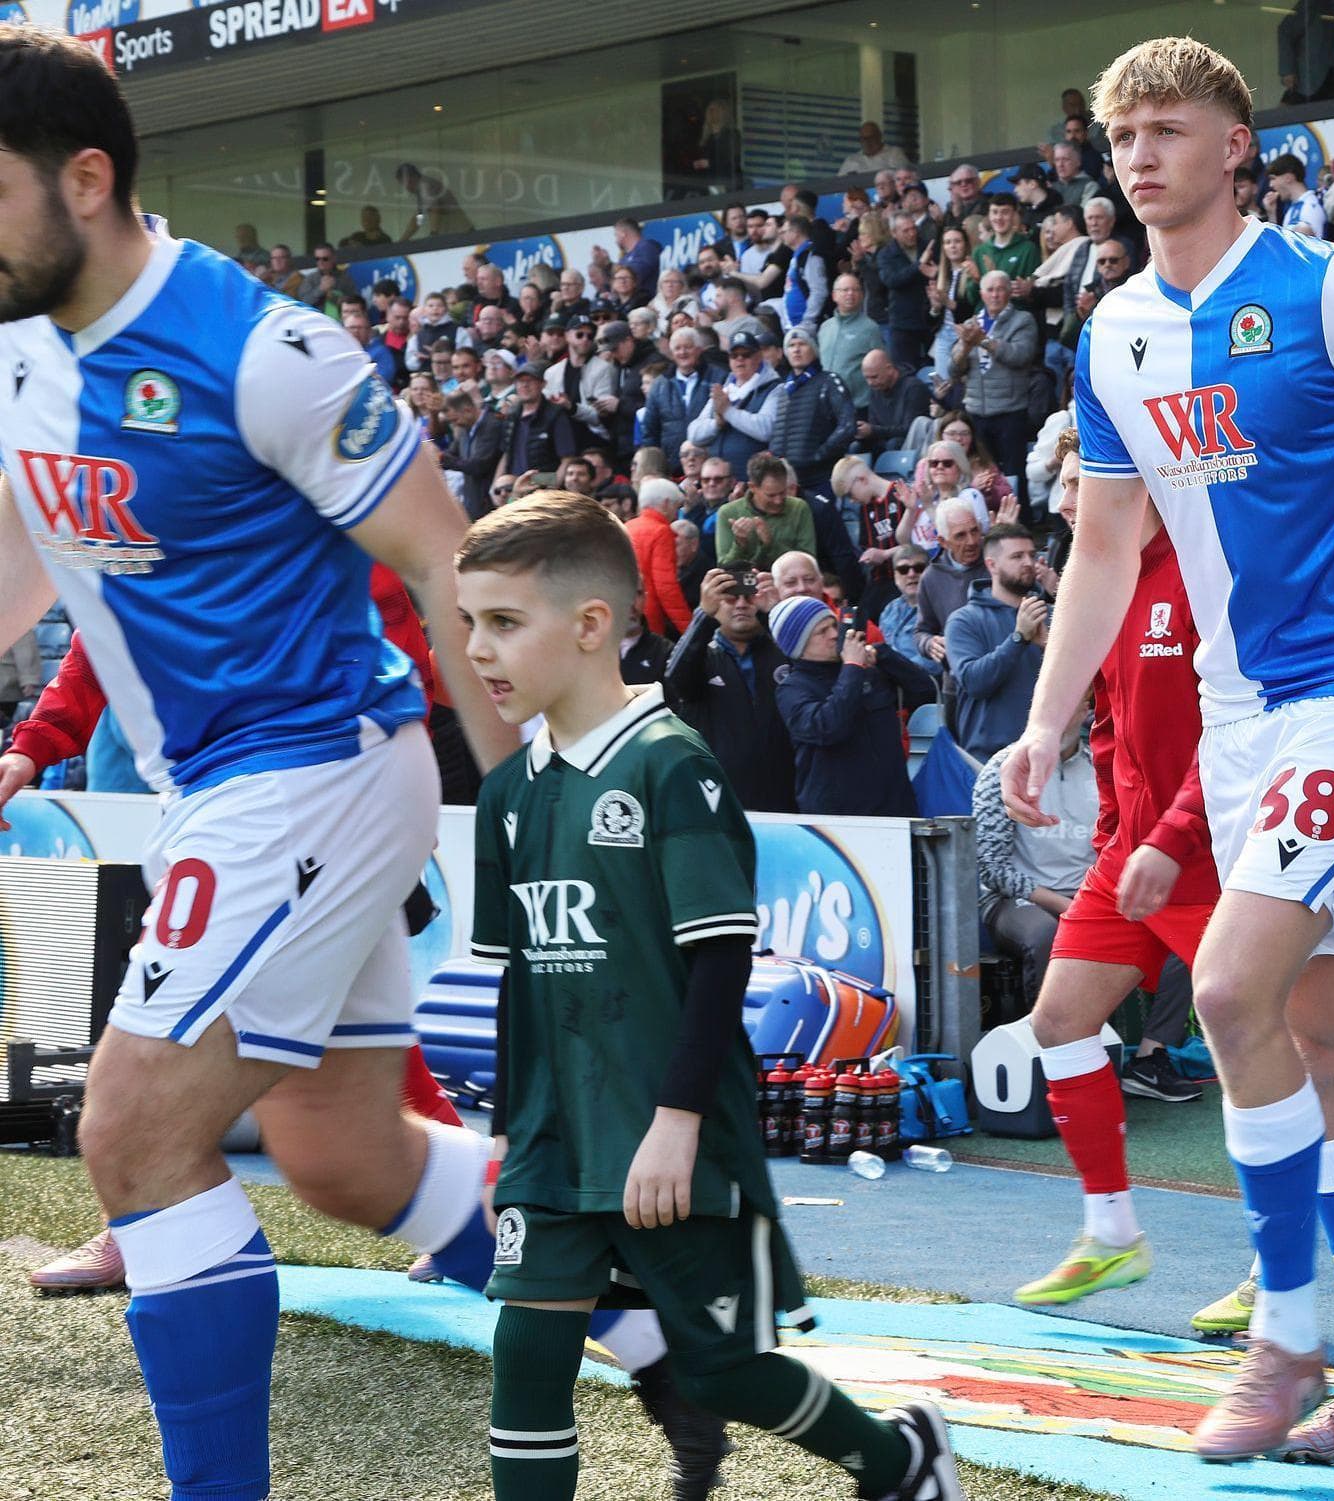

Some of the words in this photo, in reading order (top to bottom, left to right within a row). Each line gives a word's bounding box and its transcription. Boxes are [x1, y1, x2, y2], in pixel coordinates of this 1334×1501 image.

[208, 0, 320, 48] SPREAD
[327, 0, 369, 22] EX
[115, 28, 173, 71] Sports
[1142, 384, 1256, 462] WR
[1155, 453, 1256, 479] WatsonRamsbottom
[1171, 467, 1248, 490] SOLICITORS
[17, 448, 160, 544] WR
[1139, 642, 1184, 658] 32Red
[155, 857, 216, 949] 0
[509, 879, 608, 946] WR
